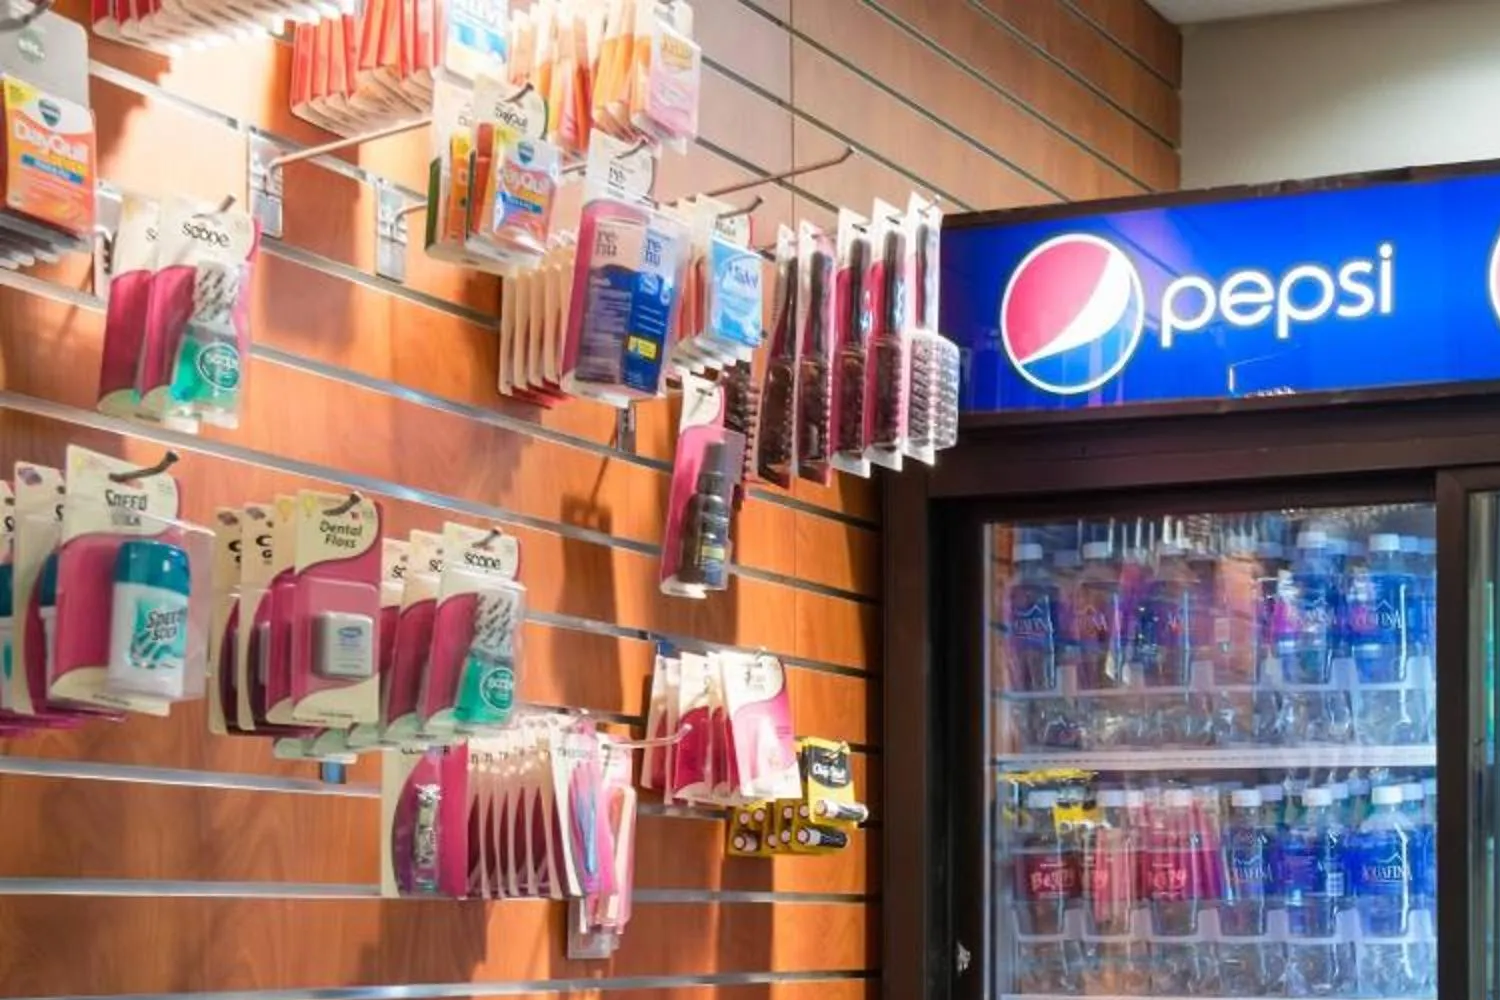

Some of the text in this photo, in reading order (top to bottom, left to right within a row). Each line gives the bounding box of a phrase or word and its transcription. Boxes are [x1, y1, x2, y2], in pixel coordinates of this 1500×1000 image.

[181, 221, 231, 248] scope
[1160, 241, 1395, 348] pepsi
[318, 520, 364, 538] Dental
[463, 552, 502, 572] scope
